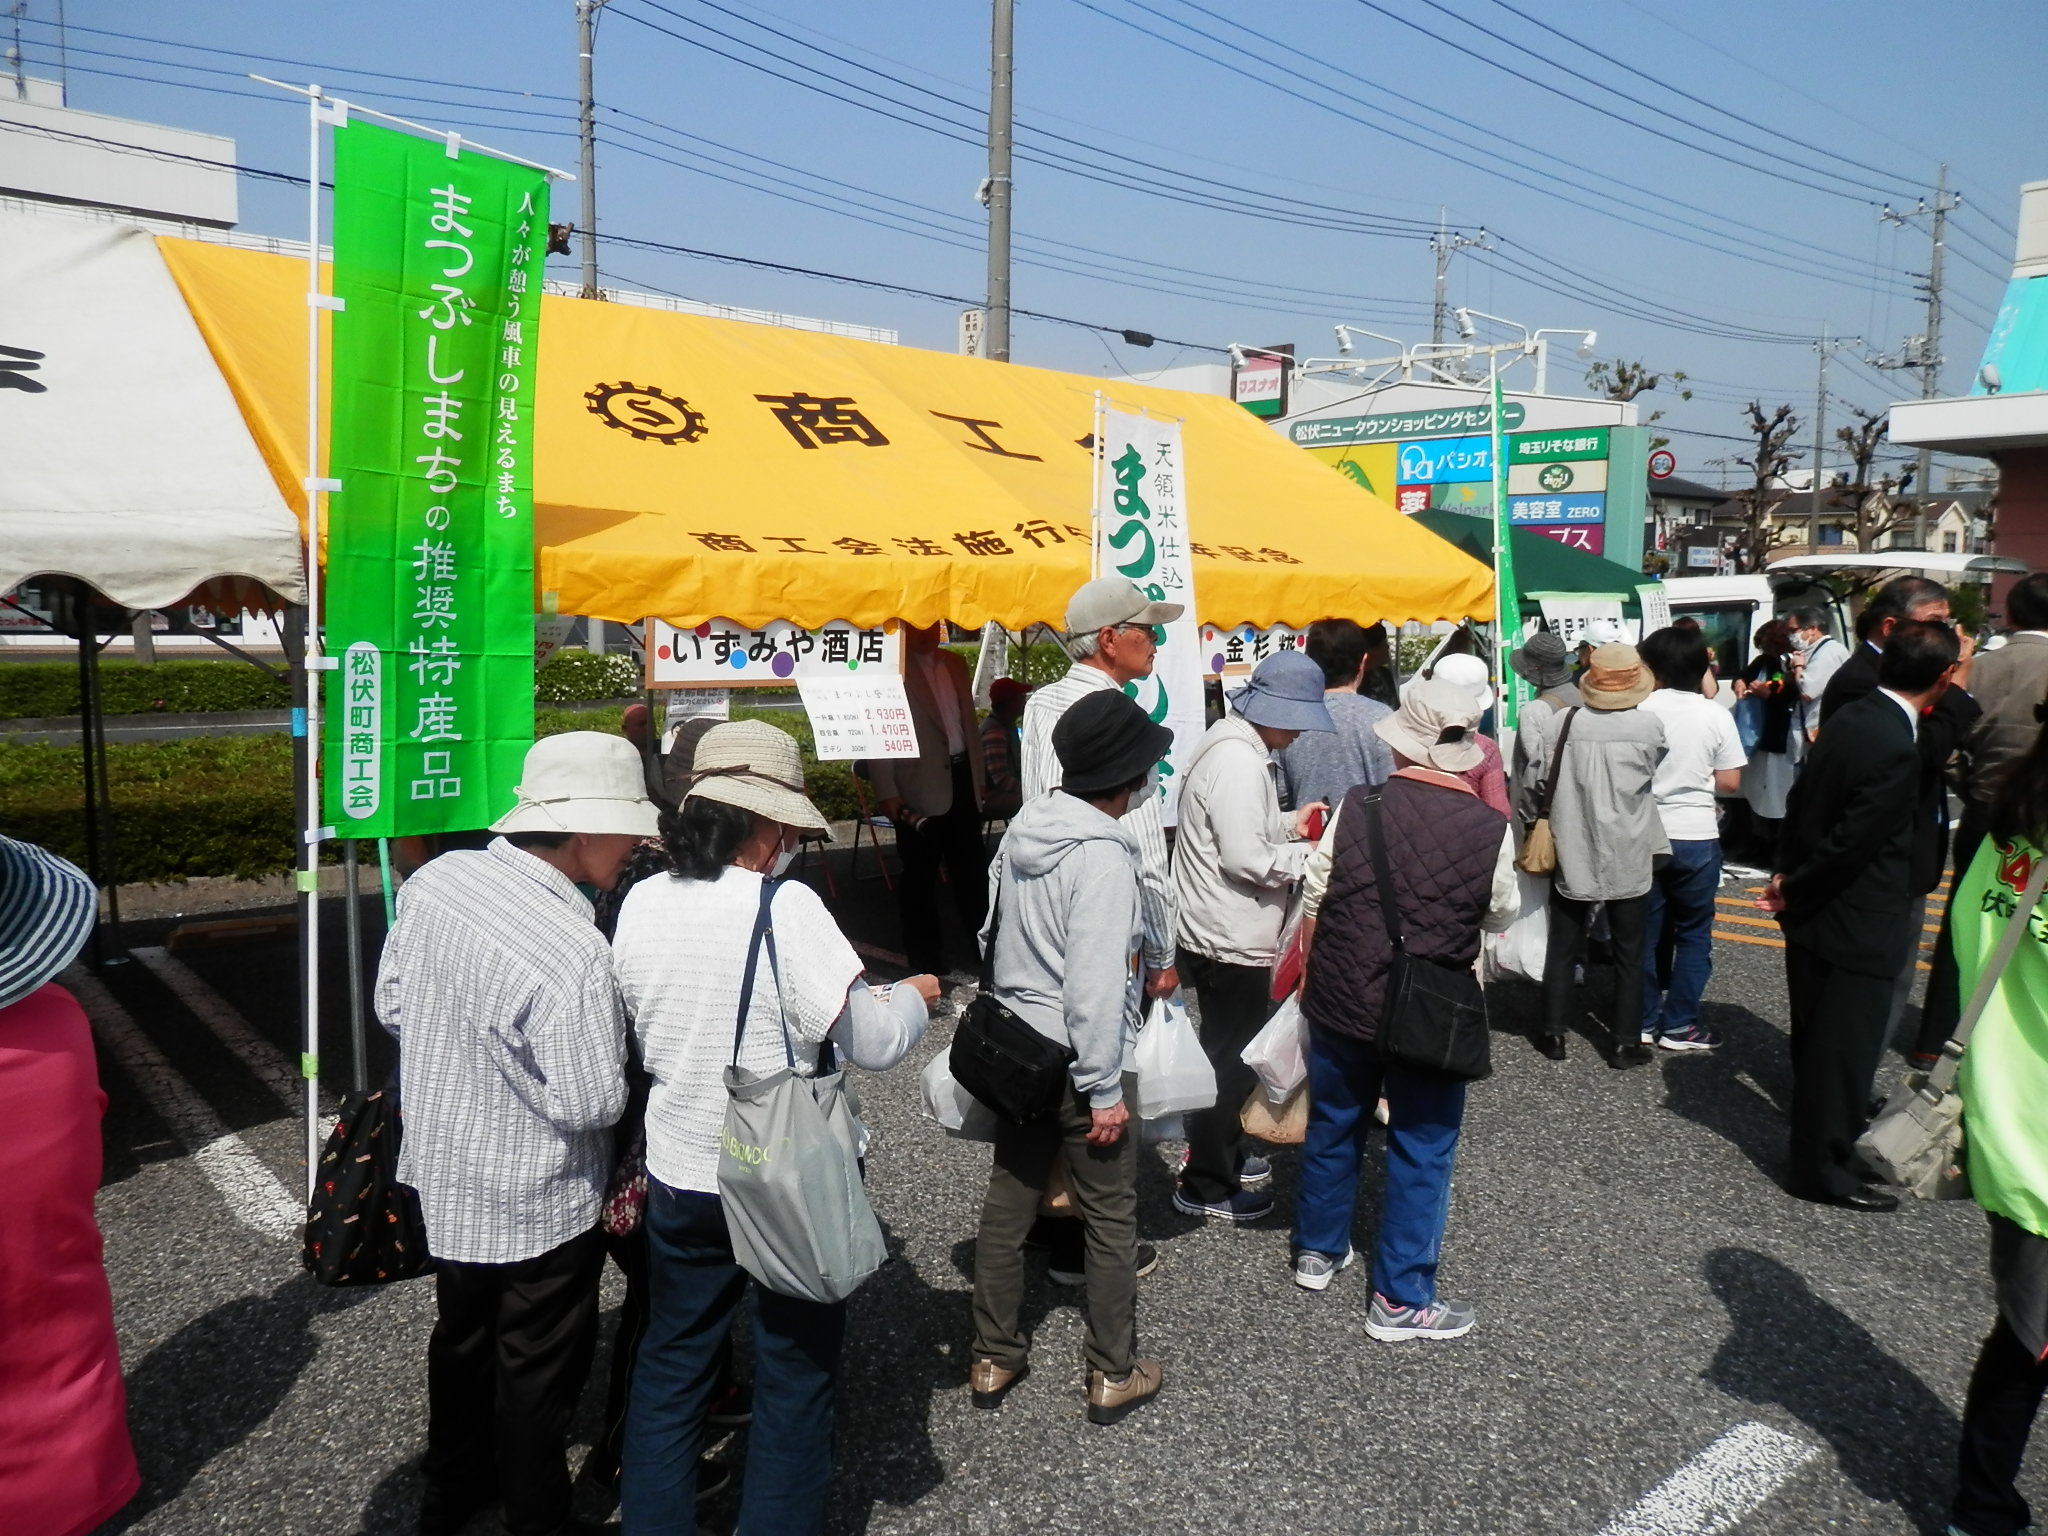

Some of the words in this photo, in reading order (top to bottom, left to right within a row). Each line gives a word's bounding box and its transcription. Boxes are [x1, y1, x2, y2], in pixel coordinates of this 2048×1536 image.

[496, 192, 535, 519] 人々が憩う風車の見えるまち
[1296, 410, 1520, 441] 松伏ニュータウンショッピングセンー
[1436, 450, 1495, 470] パシオ
[1518, 437, 1599, 455] 埼玉りそな銀行
[409, 184, 476, 801] まつぶしまちの推奨特産品
[1154, 442, 1183, 588] 天領米仕込
[1512, 501, 1562, 520] 美容室
[1567, 507, 1600, 518] ZERO
[672, 629, 884, 665] いずみや酒店
[349, 652, 375, 809] 松伏町商工会
[884, 739, 913, 751] 540円
